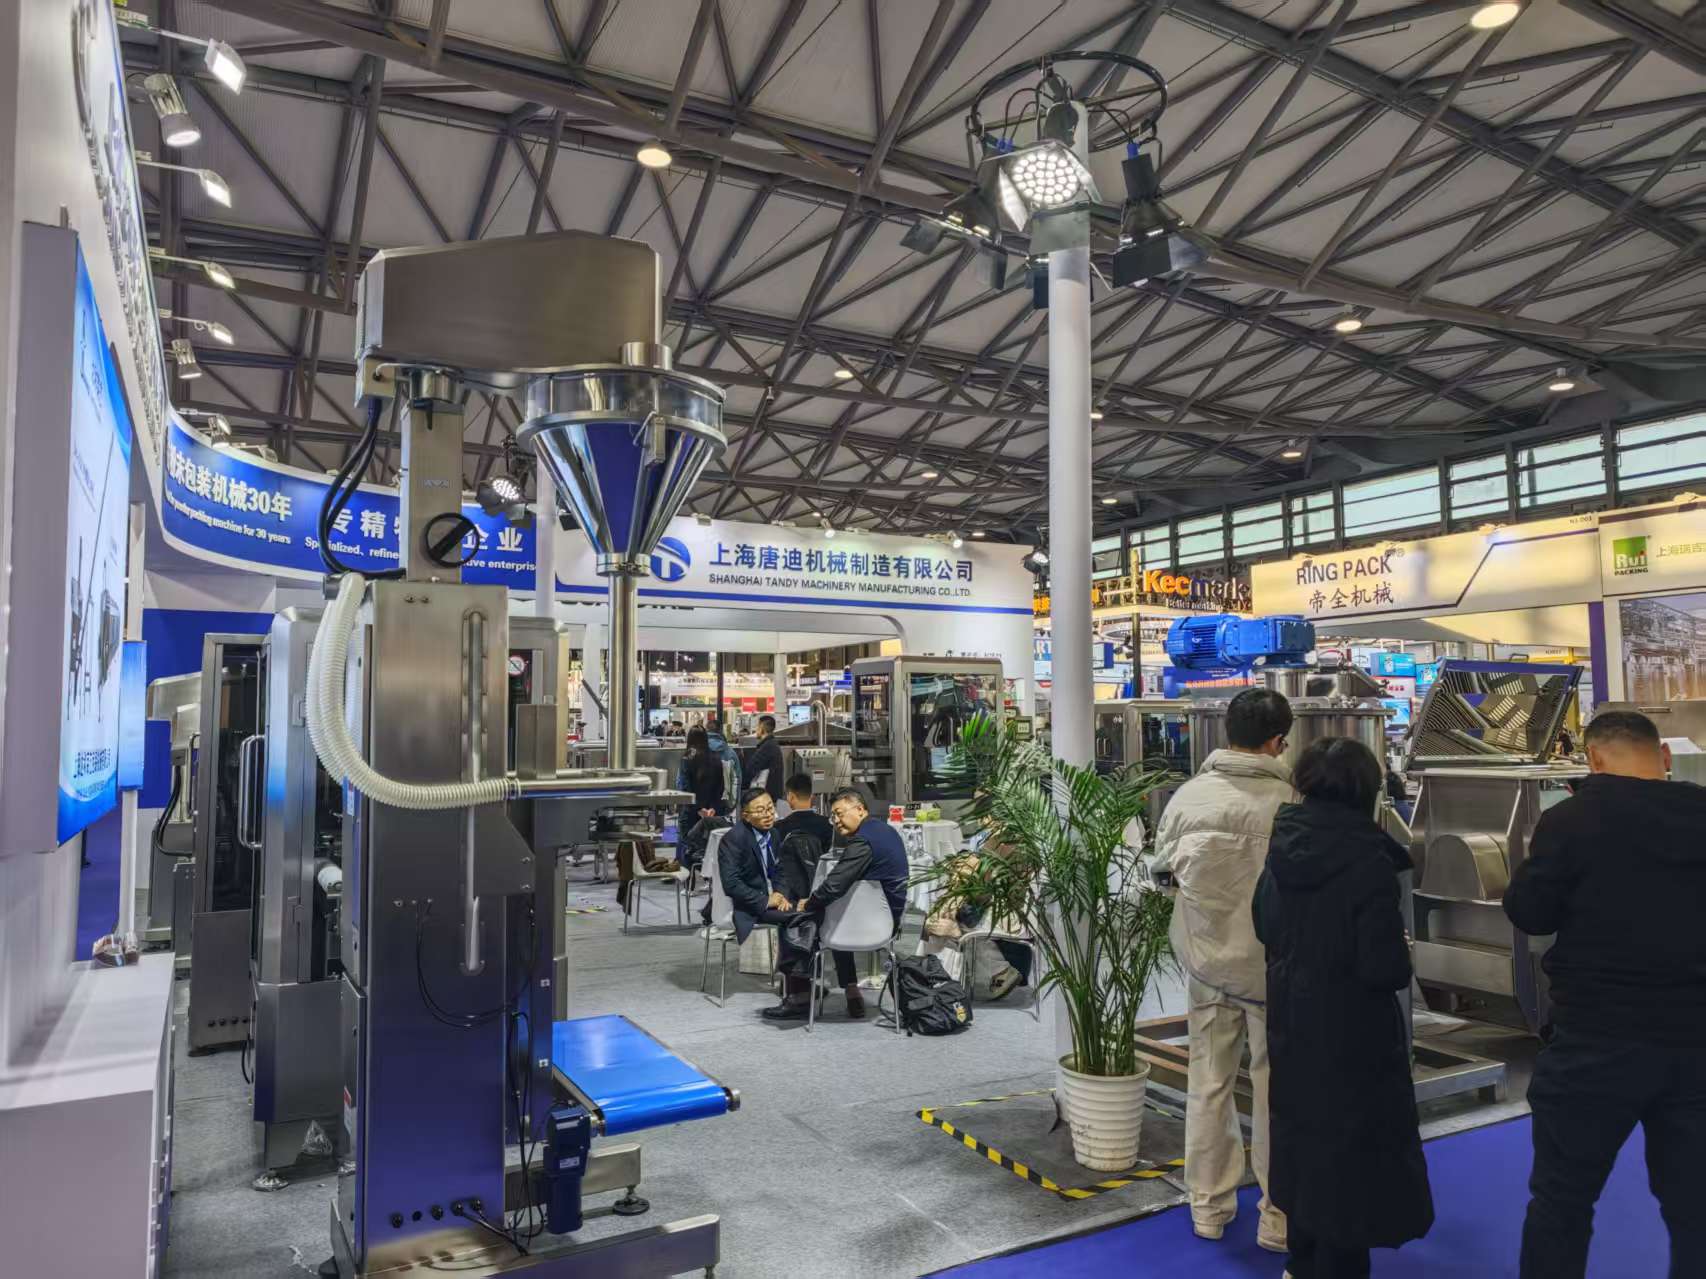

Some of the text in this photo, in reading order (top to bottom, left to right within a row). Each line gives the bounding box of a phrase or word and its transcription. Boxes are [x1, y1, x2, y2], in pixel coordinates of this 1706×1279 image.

[243, 522, 255, 537] for
[256, 528, 267, 539] 30
[267, 532, 291, 545] years
[369, 546, 400, 560] refine
[709, 541, 973, 582] 上海唐迪机械制造有限公司
[1296, 555, 1393, 585] RING PACK
[1614, 567, 1649, 576] PACKING
[709, 573, 763, 586] SHANGHAI
[765, 576, 799, 588] TANDY
[801, 579, 856, 591] MACHINERY
[858, 582, 936, 596] MANUFACTURING
[1308, 580, 1394, 615] 帝全机械
